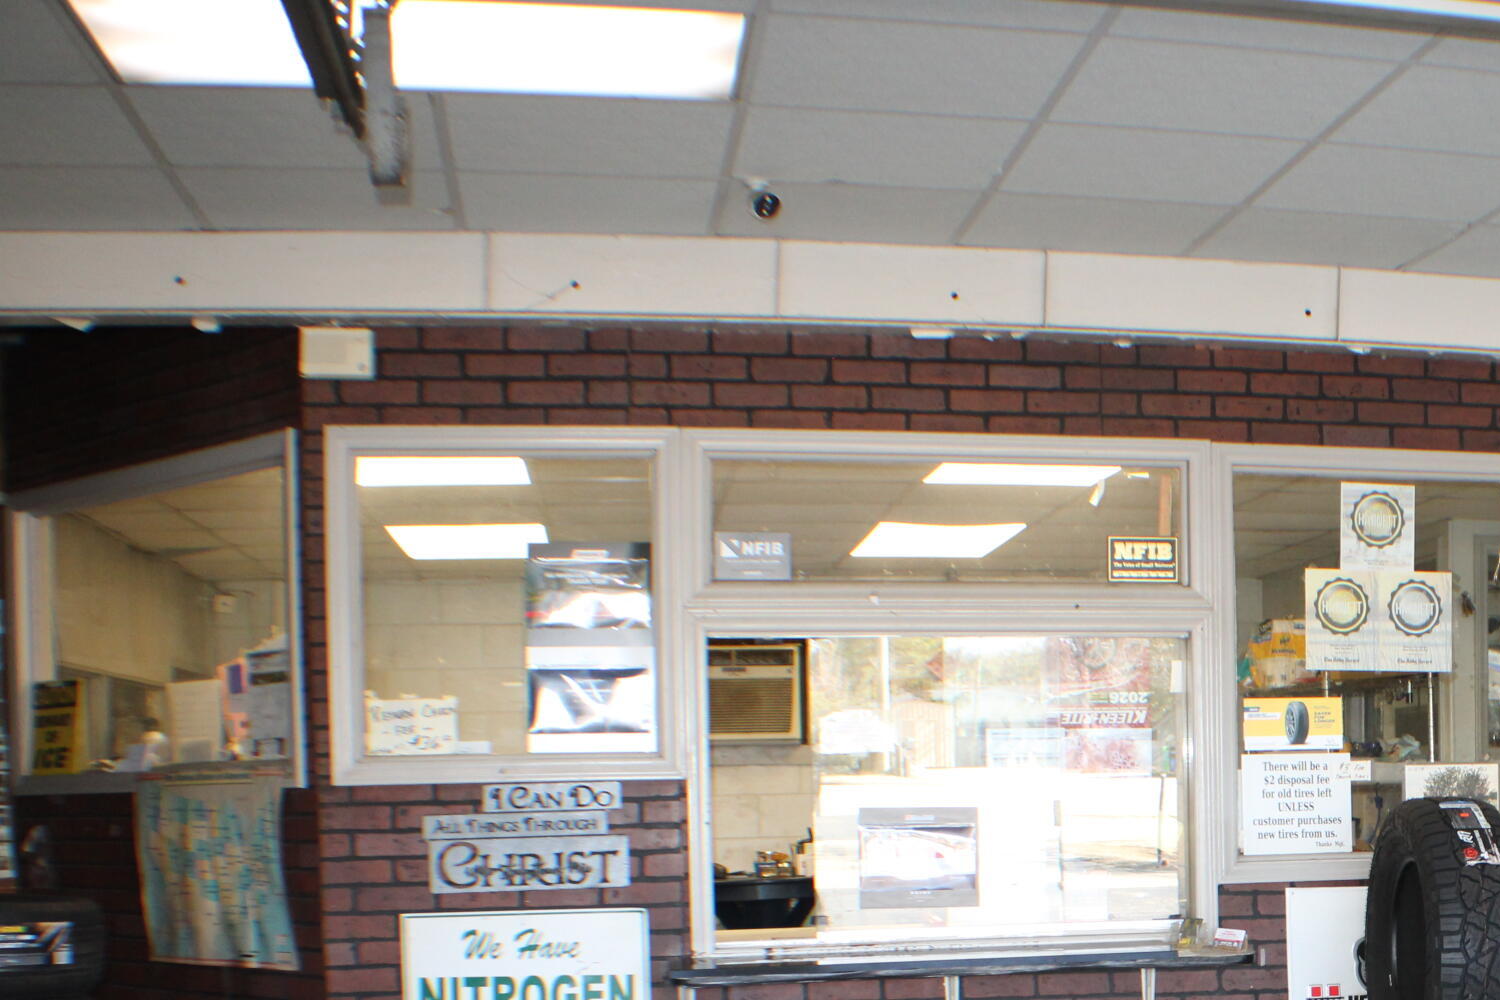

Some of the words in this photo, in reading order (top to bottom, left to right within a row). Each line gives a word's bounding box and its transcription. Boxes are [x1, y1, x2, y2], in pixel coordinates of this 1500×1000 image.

[740, 541, 785, 556] NFIB
[1113, 541, 1173, 561] NFIB
[1263, 761, 1290, 771] There
[1291, 761, 1307, 771] will
[1310, 761, 1320, 771] be
[1264, 775, 1275, 785] $2
[1278, 775, 1314, 786] disposal
[1316, 775, 1330, 784] fee
[508, 786, 563, 809] CAN
[569, 785, 615, 807] DO
[1262, 789, 1275, 798] for
[1278, 789, 1291, 798] old
[1294, 789, 1314, 798] tires
[1317, 788, 1331, 798] left
[1278, 802, 1314, 812] UNLESS
[432, 820, 462, 833] ALL
[465, 819, 520, 833] THINGS
[523, 817, 598, 832] THROUGH
[1253, 817, 1295, 826] customer
[1297, 816, 1342, 827] purchases
[1258, 831, 1275, 839] new
[1278, 829, 1298, 839] tires
[1301, 829, 1322, 839] from
[1325, 830, 1338, 838] us.
[438, 841, 620, 889] CHRIST
[461, 929, 501, 959] We
[513, 928, 581, 959] Have
